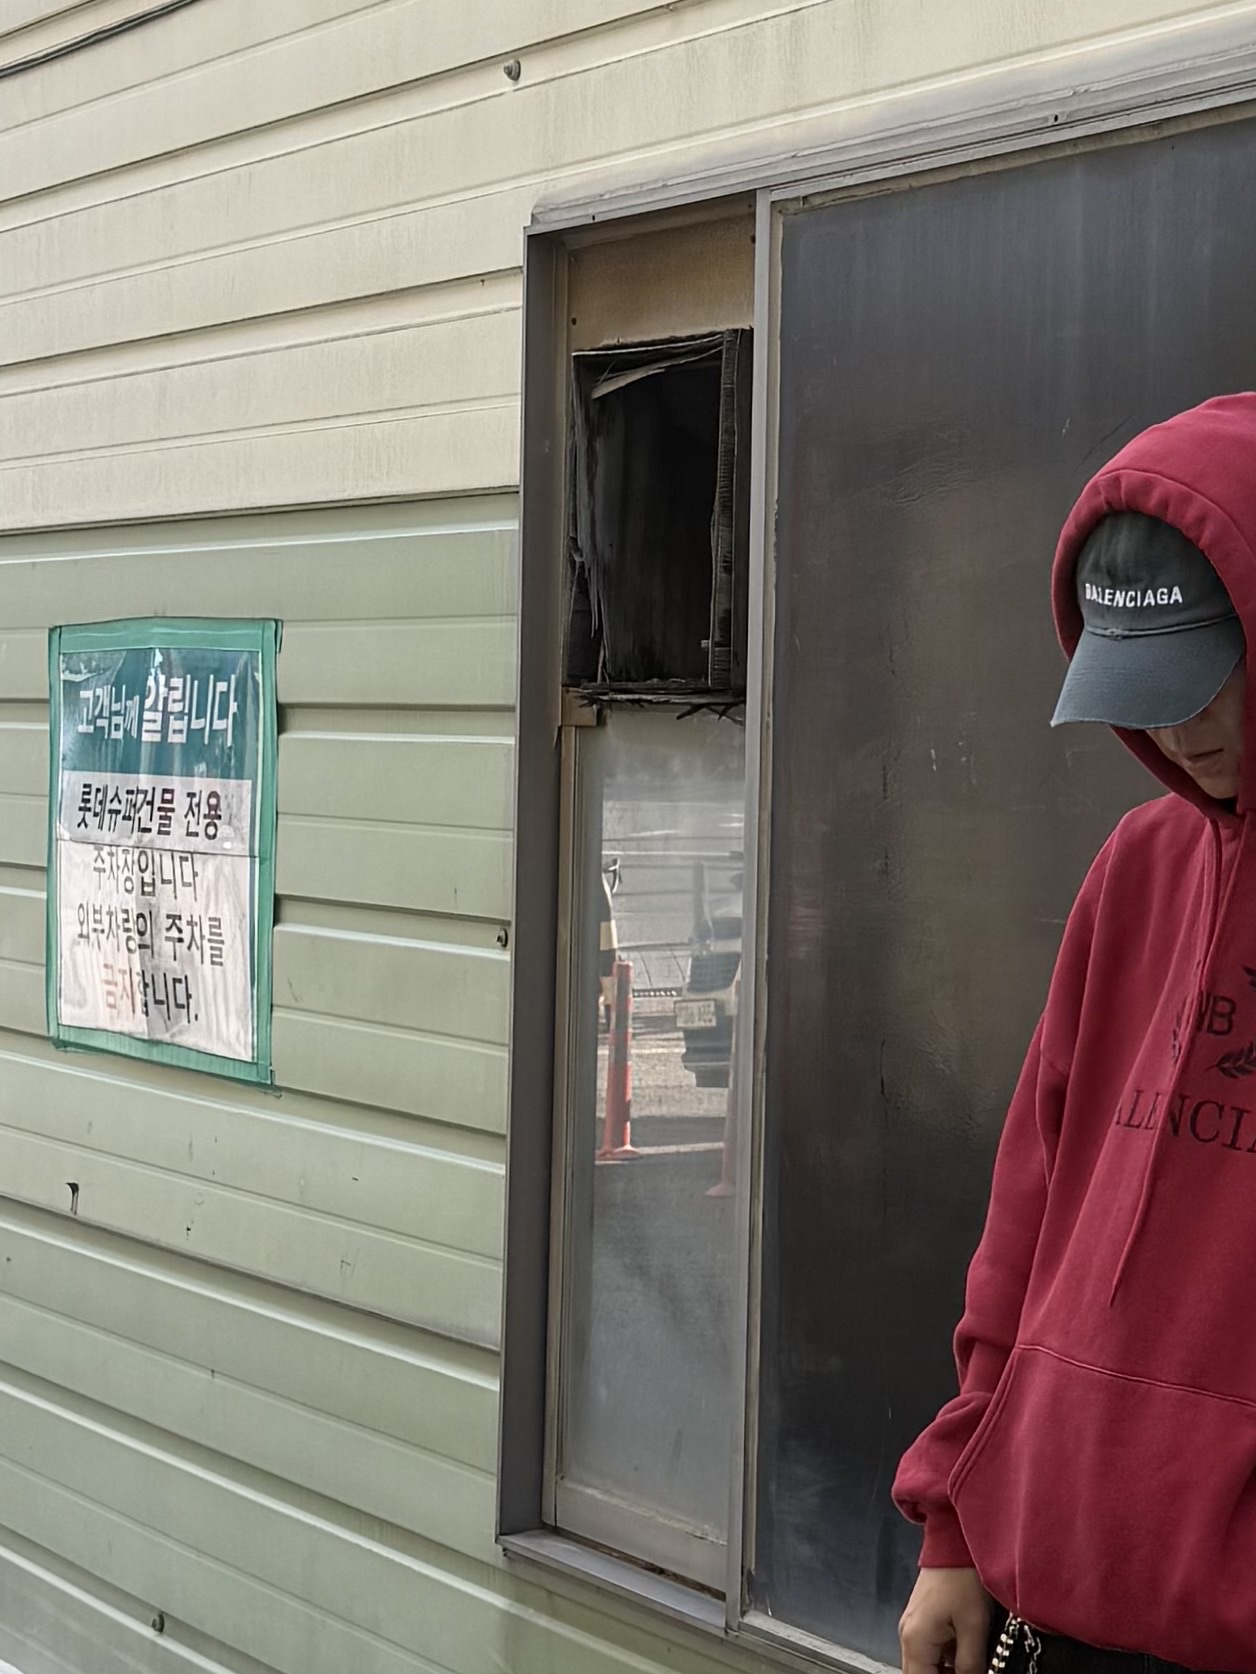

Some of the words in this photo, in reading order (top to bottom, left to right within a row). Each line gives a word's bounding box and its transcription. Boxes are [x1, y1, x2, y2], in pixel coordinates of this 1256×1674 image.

[1085, 582, 1183, 608] BALENCIAGA
[141, 674, 238, 747] 알립니다
[184, 789, 222, 841] 전용
[93, 845, 199, 902] 주차장입니다
[77, 901, 155, 959] 외부차량의
[165, 913, 225, 967] 주차를
